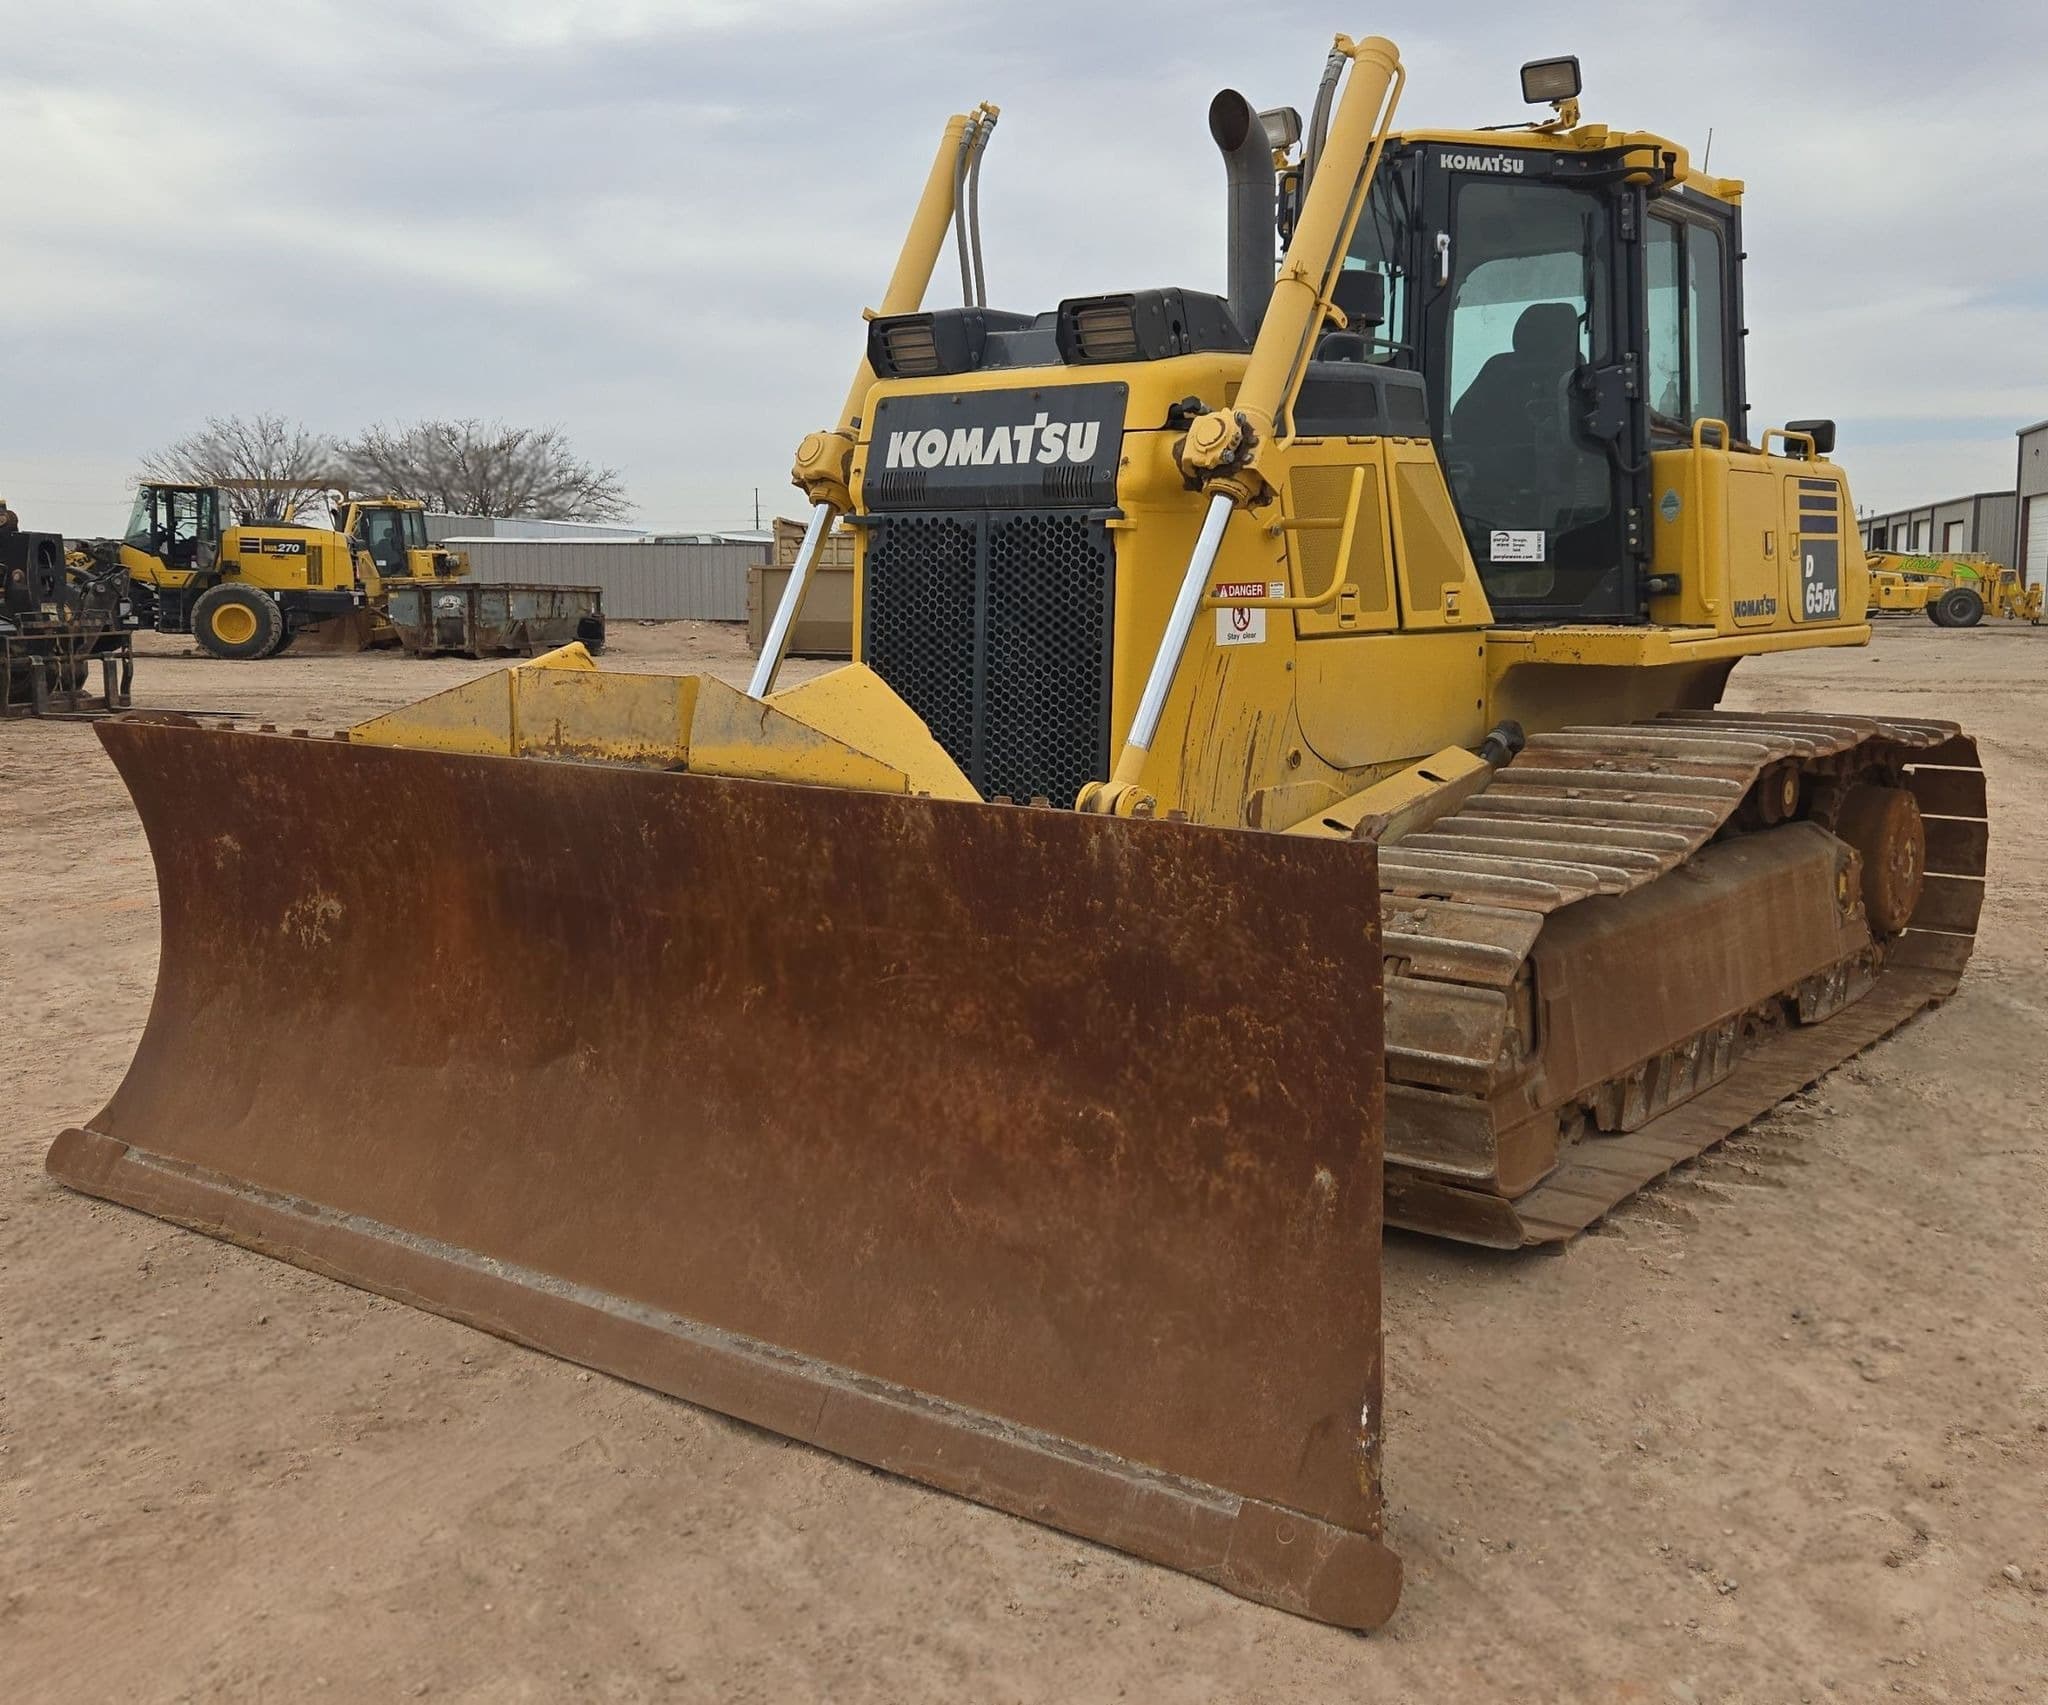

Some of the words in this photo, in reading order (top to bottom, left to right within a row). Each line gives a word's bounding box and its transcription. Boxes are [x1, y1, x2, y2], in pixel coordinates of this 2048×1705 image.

[1440, 154, 1524, 174] KOMATSU
[885, 412, 1101, 469] KOMATSU
[1805, 554, 1814, 578] D
[1228, 584, 1263, 597] DANGER
[1733, 593, 1776, 618] KOMATSU
[1227, 632, 1240, 641] Stay
[1242, 632, 1256, 640] clear
